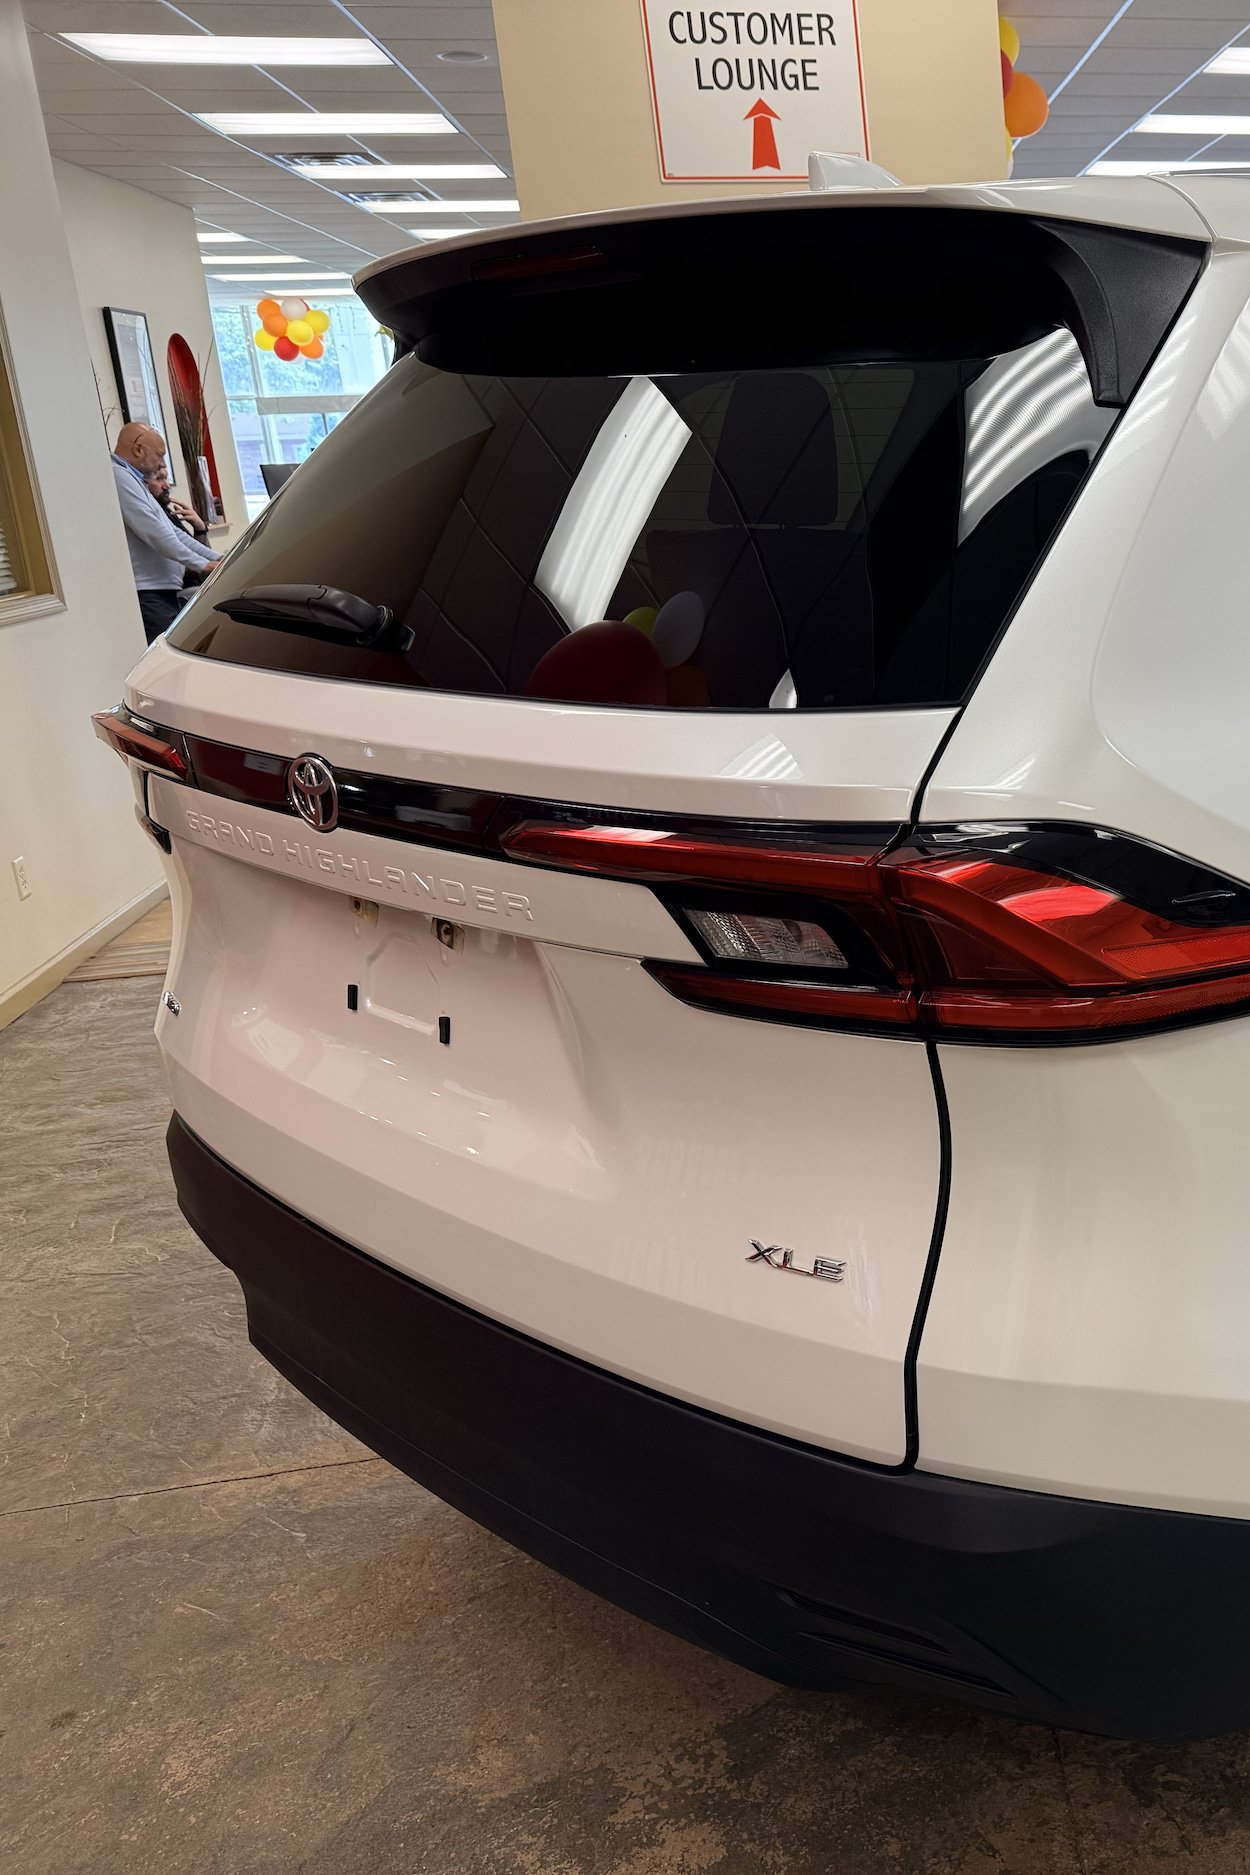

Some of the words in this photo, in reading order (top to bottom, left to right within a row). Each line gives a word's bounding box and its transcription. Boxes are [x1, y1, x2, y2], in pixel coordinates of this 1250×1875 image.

[668, 11, 837, 46] CUSTOMER
[694, 58, 820, 91] LOUNGE
[186, 809, 274, 857] GRAND
[282, 839, 534, 921] HIGHLANDER
[745, 1239, 847, 1282] XLE
